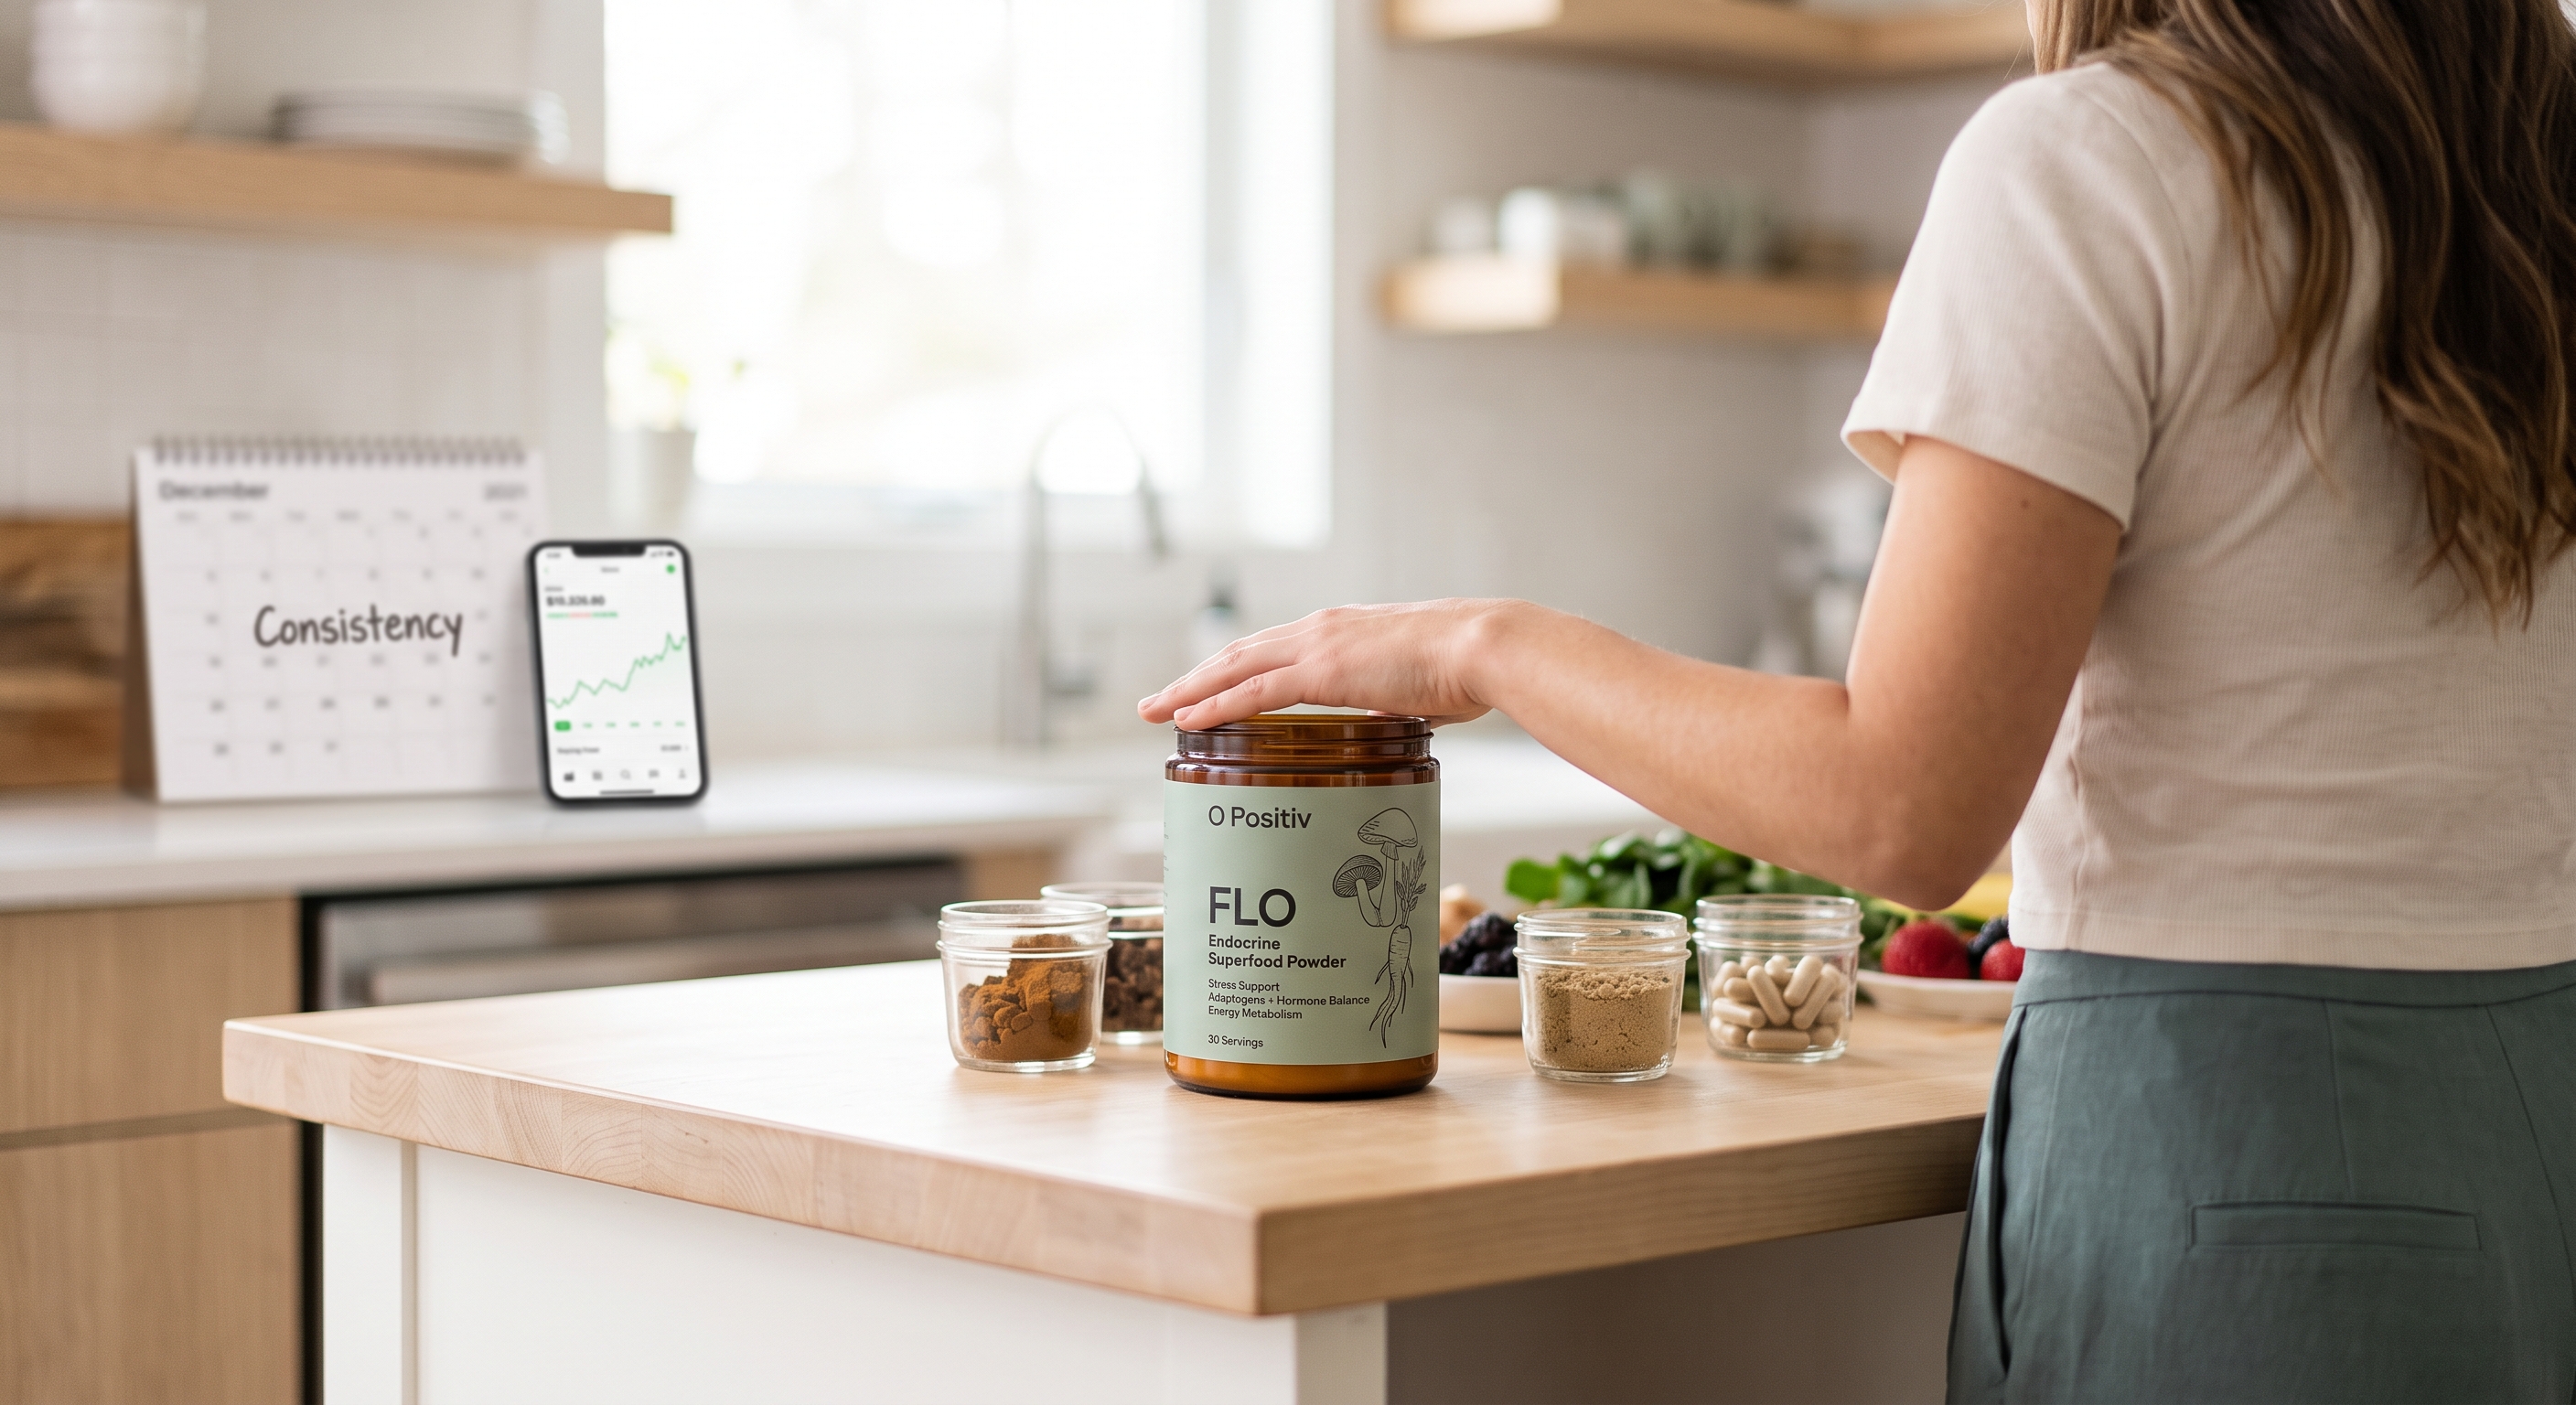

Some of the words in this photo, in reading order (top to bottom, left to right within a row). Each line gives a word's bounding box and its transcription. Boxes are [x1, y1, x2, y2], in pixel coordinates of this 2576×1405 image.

[158, 480, 269, 500] December
[253, 604, 463, 658] Consistency
[1208, 805, 1225, 826] O
[1231, 806, 1312, 829] Positiv
[1209, 885, 1297, 928] FLO
[1208, 934, 1281, 950] Endocrine
[1208, 951, 1283, 969] Superfood
[1287, 954, 1347, 969] Powder
[1208, 978, 1237, 990] Stress
[1239, 981, 1280, 992] Support
[1208, 992, 1266, 1005] Adaptogens
[1276, 995, 1327, 1006] Hormone
[1329, 995, 1370, 1005] Balance
[1208, 1005, 1240, 1019] Energy
[1241, 1008, 1303, 1020] Metabolism
[1208, 1035, 1220, 1045] 30
[1221, 1035, 1264, 1048] Servings
